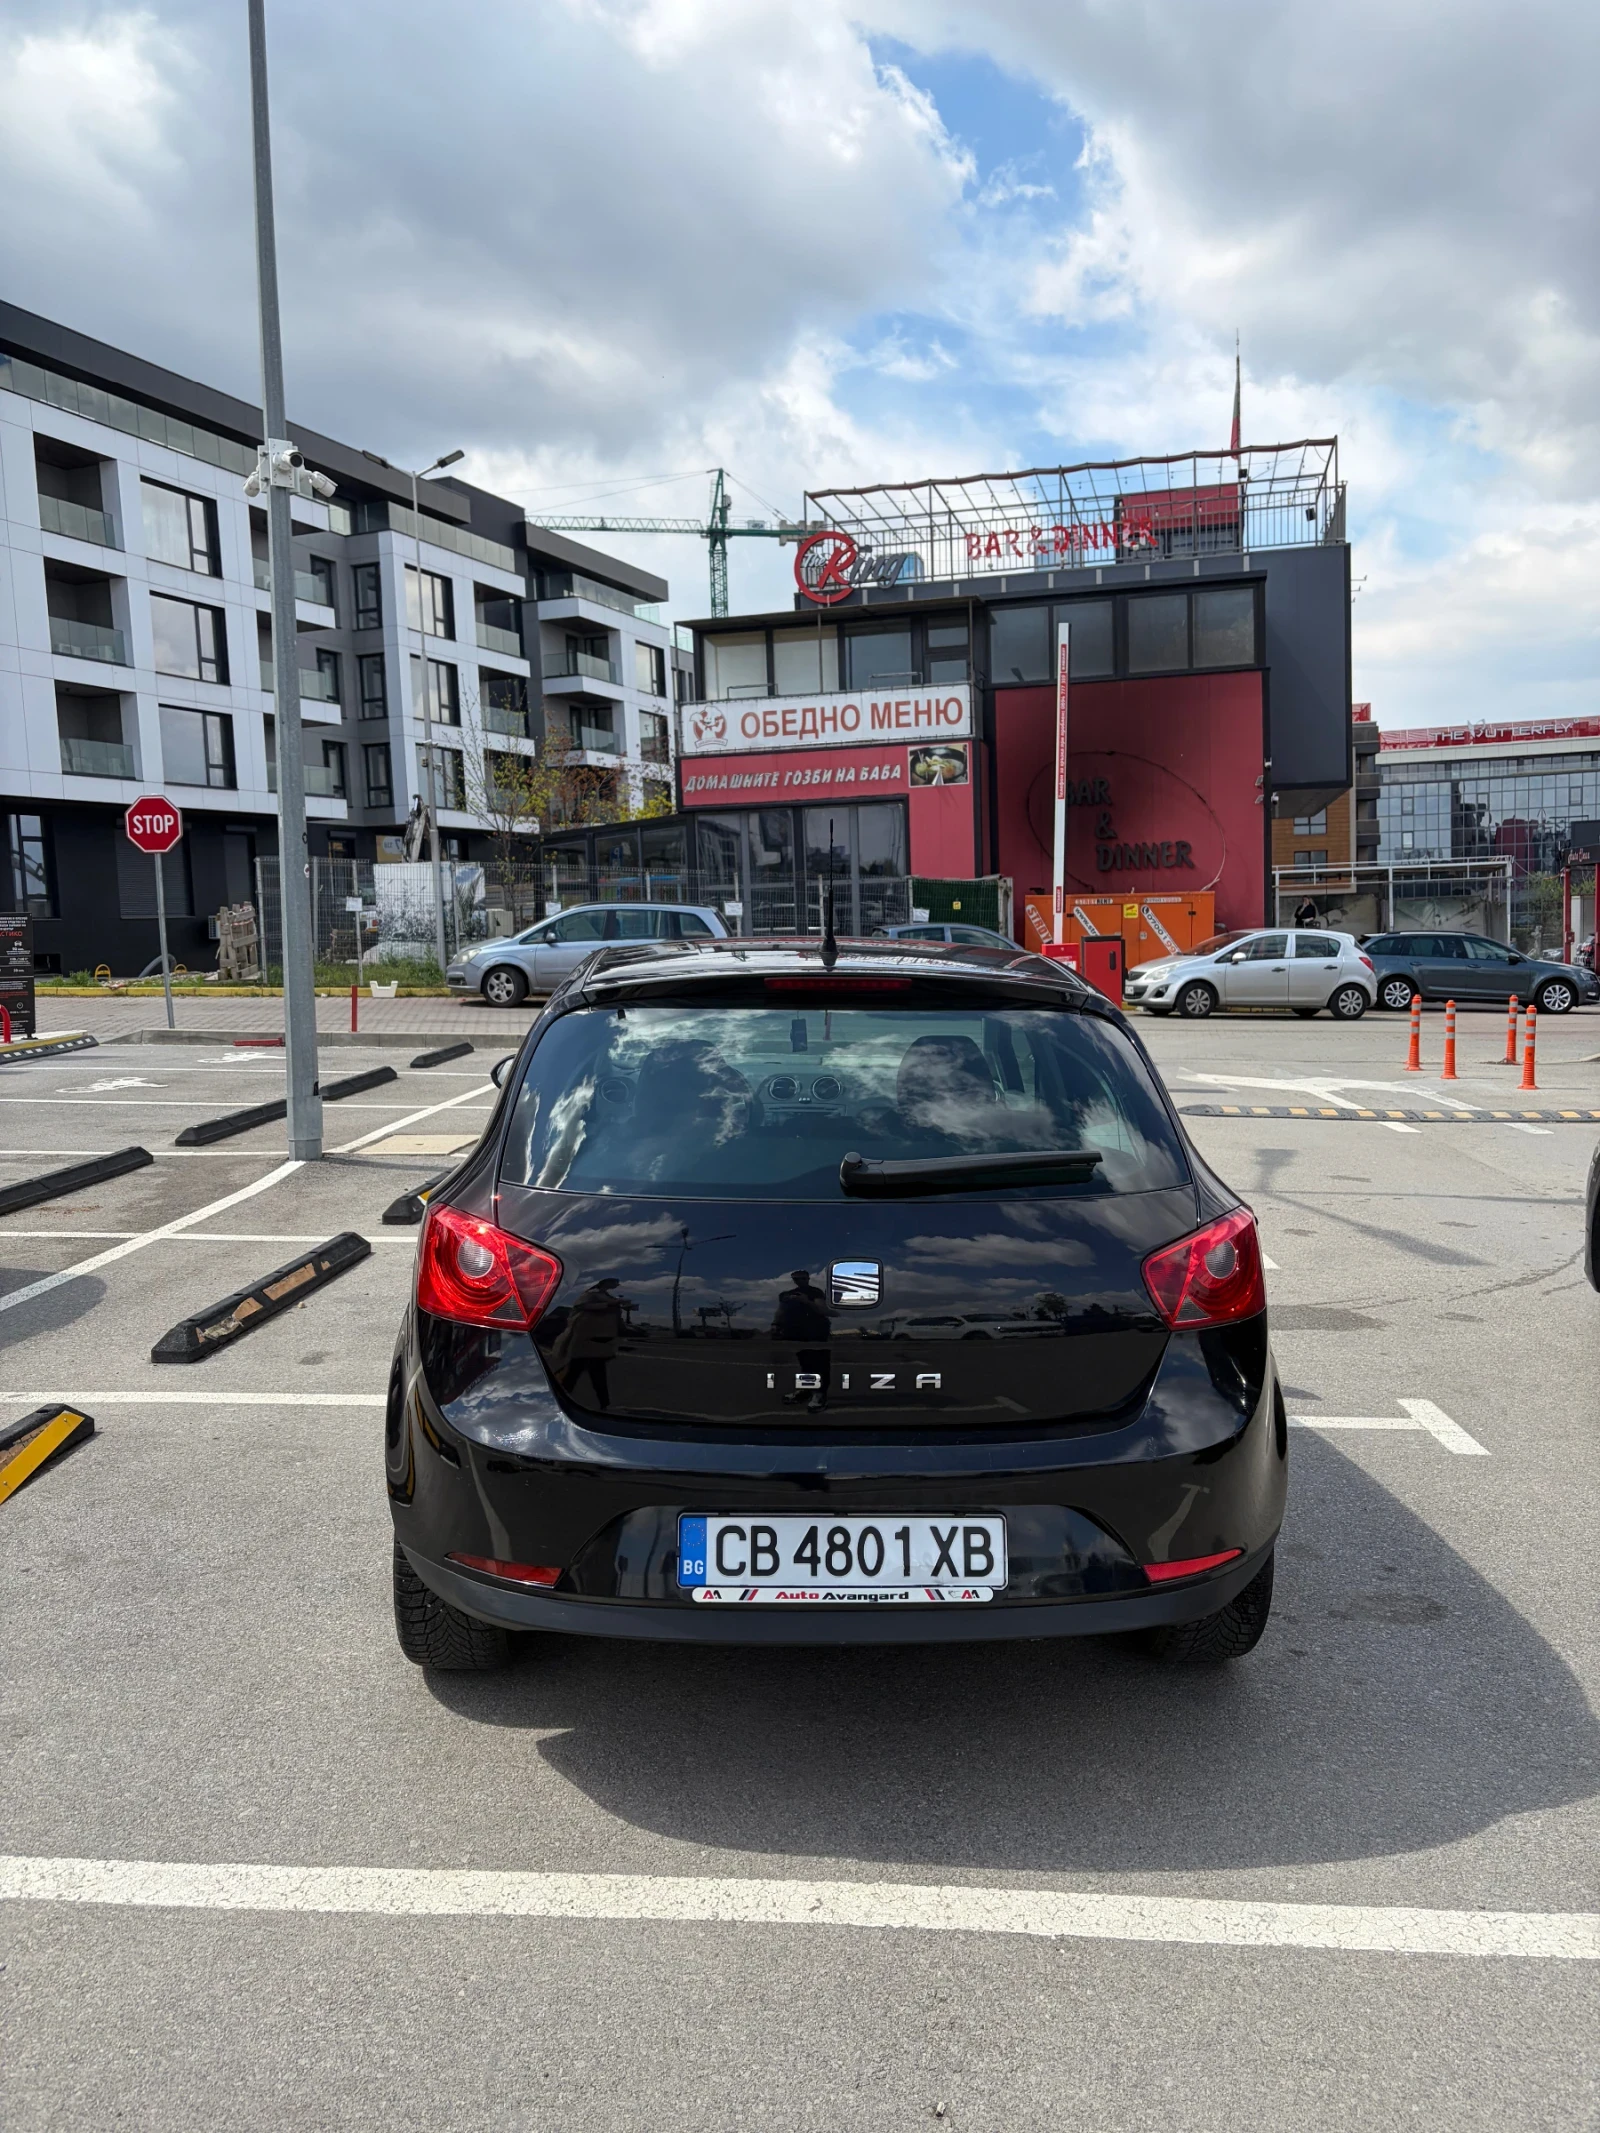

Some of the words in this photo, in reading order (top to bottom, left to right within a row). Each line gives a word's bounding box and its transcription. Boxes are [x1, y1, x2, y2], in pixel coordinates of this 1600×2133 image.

[817, 544, 908, 589] Ring
[740, 704, 861, 740] ОБЕДНО
[870, 697, 964, 730] МЕНЮ
[1431, 730, 1465, 742] THE
[684, 770, 780, 793] ДОМАШНИТЕ
[783, 768, 831, 787] ГОЗБИ
[835, 767, 856, 783] НА
[859, 763, 901, 782] БАБА
[133, 814, 175, 835] STOP
[1094, 812, 1118, 840] &
[1095, 840, 1195, 873] DINNER
[1027, 906, 1053, 943] STROY
[1075, 907, 1098, 935] www.str
[766, 1372, 942, 1389] IBIZA
[716, 1525, 780, 1577] CB
[793, 1525, 911, 1577] 4801
[929, 1526, 995, 1578] XB
[683, 1559, 704, 1575] BG
[775, 1591, 820, 1600] Auto
[822, 1591, 910, 1602] Avangard
